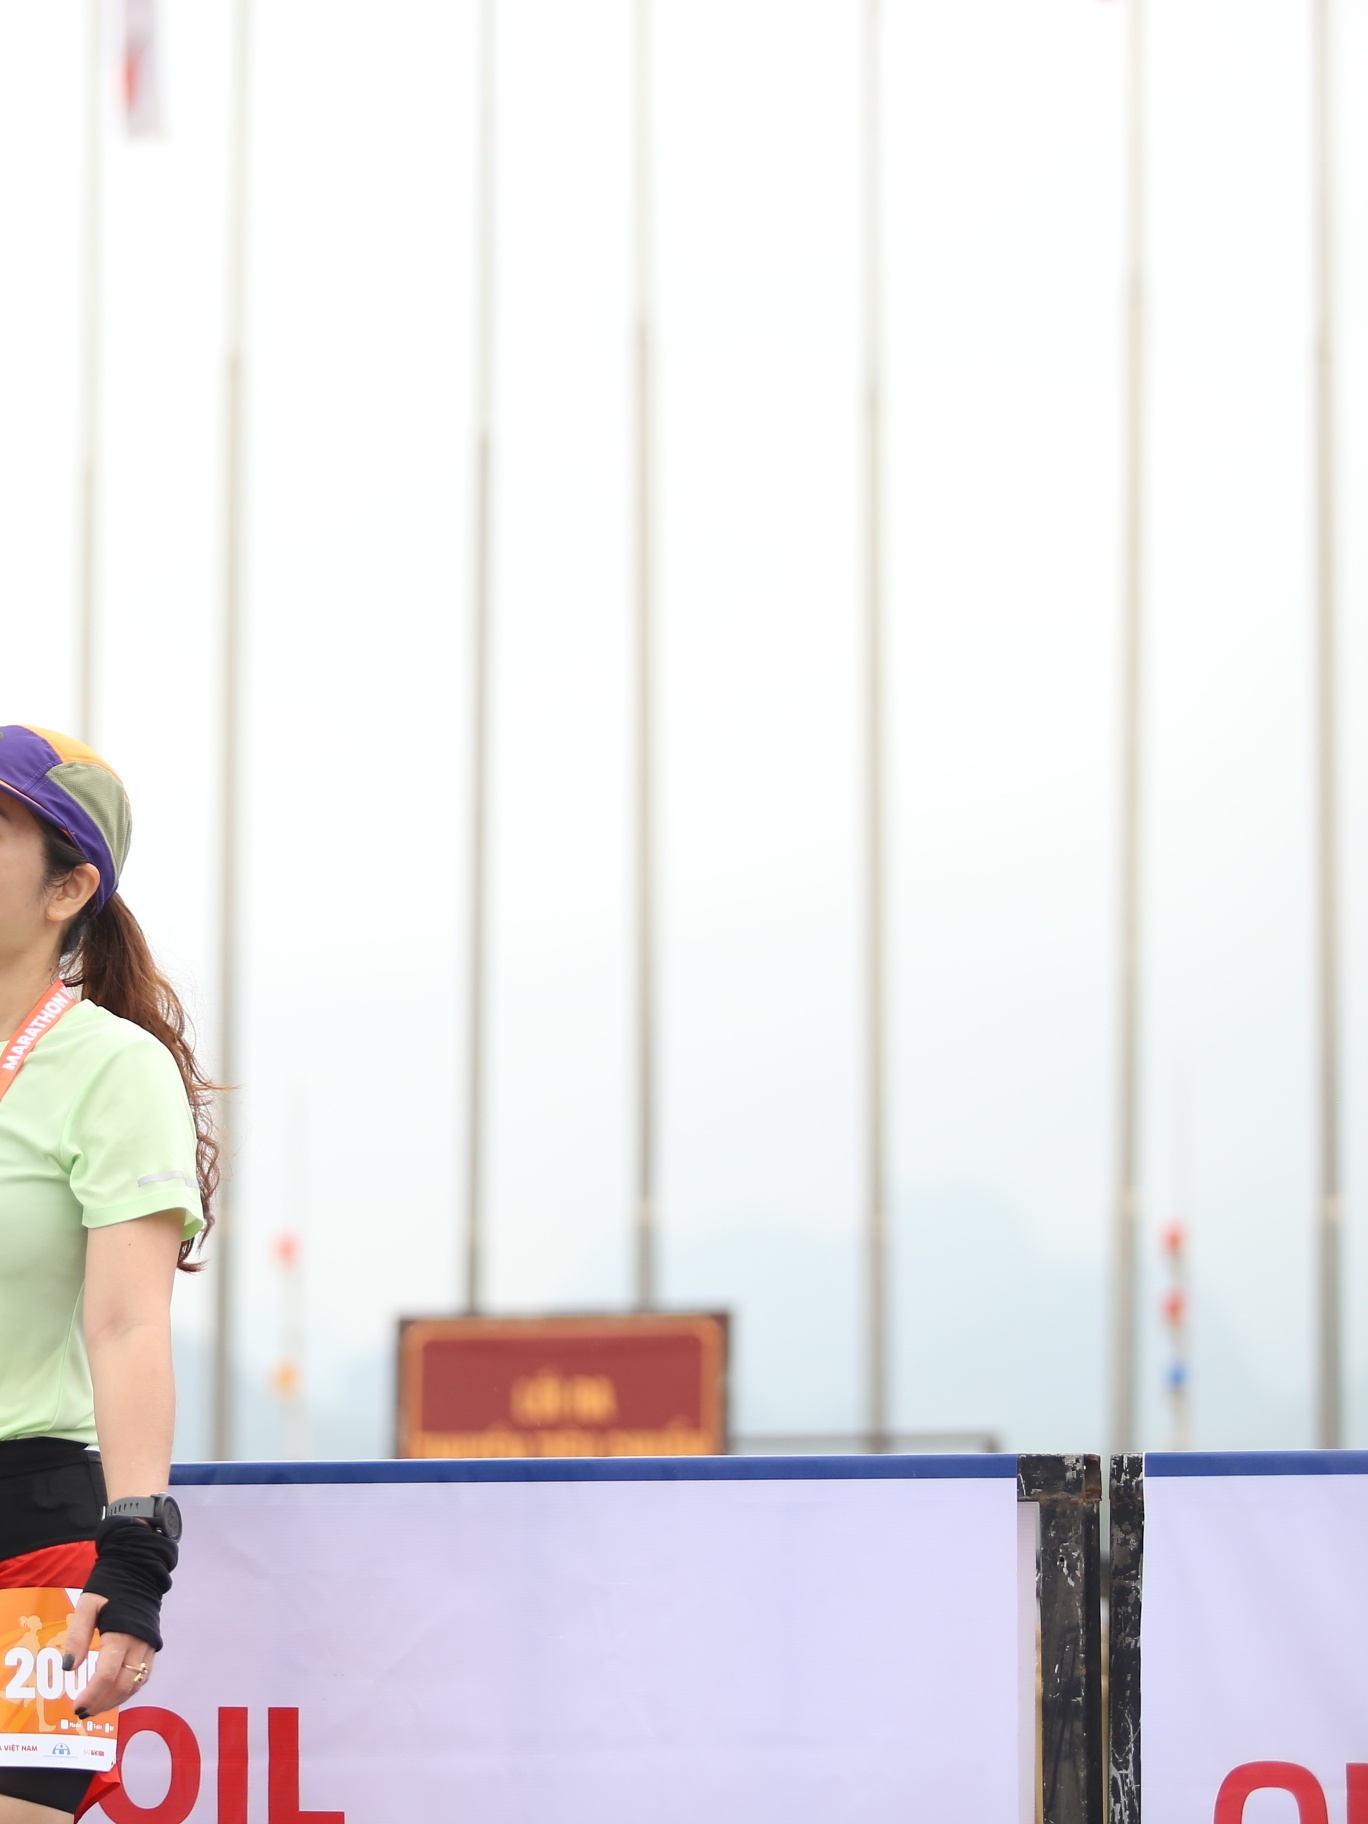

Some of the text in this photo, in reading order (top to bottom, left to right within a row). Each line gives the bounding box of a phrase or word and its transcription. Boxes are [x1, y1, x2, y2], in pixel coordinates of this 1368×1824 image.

[1, 992, 69, 1071] MARATHON
[4, 1743, 20, 1754] VIỆT
[21, 1744, 38, 1752] NAM
